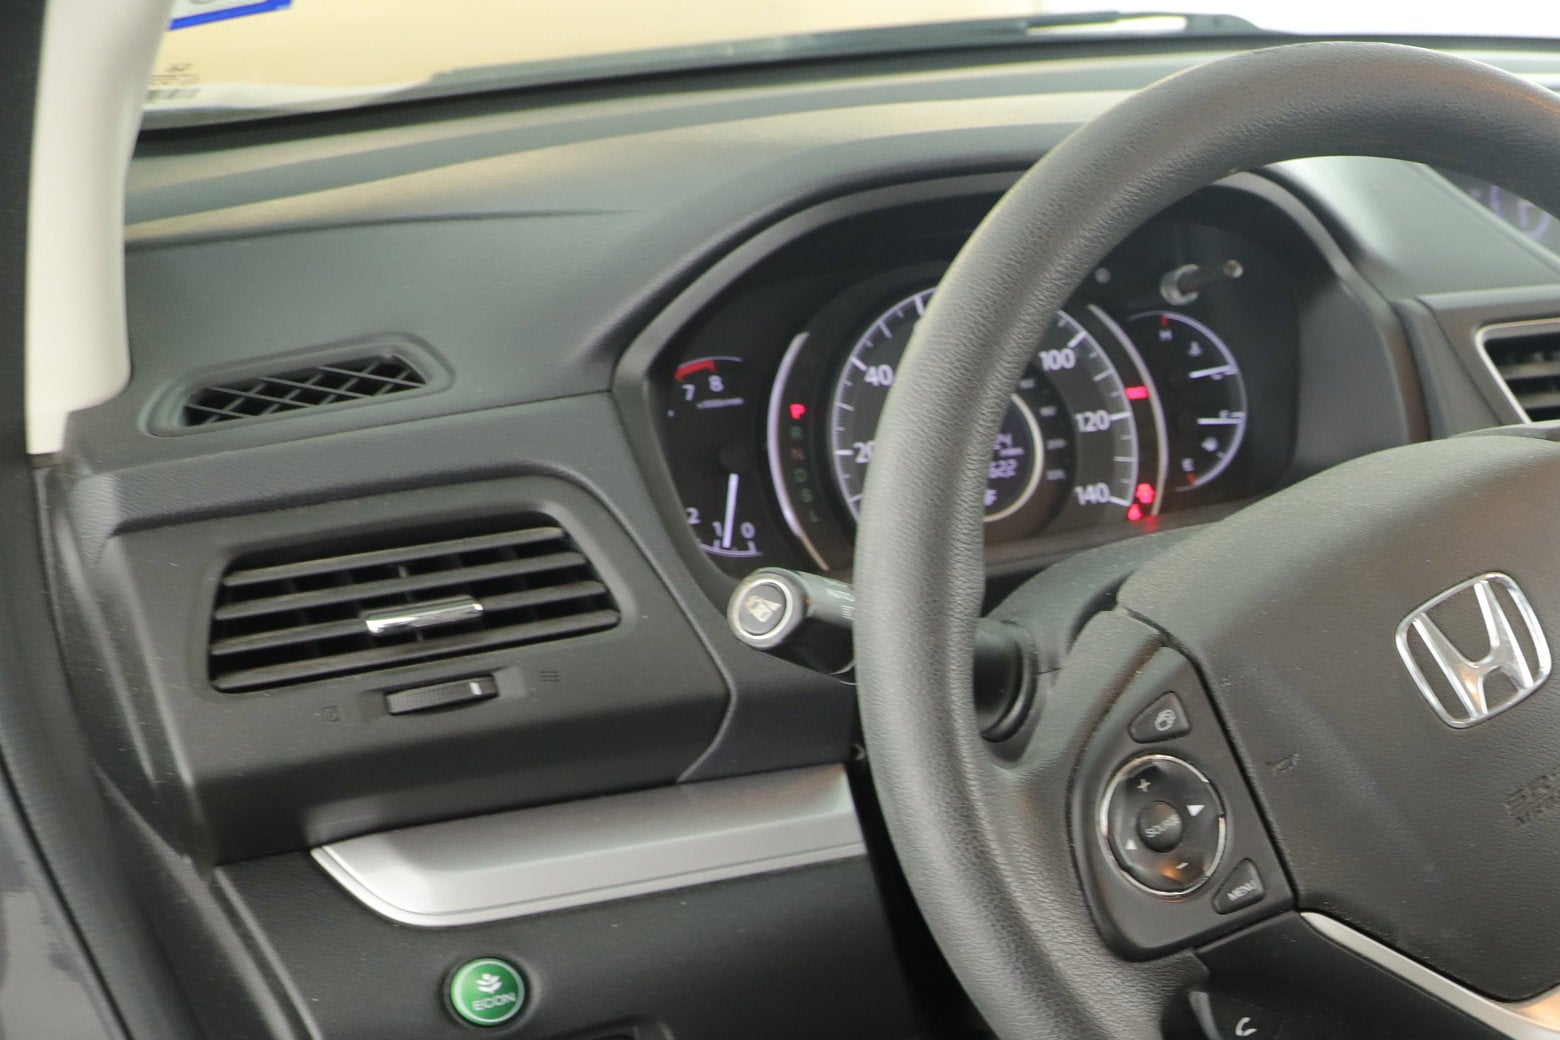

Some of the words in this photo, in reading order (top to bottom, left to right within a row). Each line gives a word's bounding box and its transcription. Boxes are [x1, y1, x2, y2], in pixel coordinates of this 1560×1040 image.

[1038, 347, 1077, 372] 100
[708, 374, 724, 392] 8
[863, 364, 894, 388] 40
[681, 384, 696, 401] 7
[788, 403, 806, 419] P
[1074, 409, 1112, 433] 120
[1074, 482, 1111, 507] 140
[685, 506, 701, 526] 2
[740, 521, 756, 539] 0
[1226, 879, 1258, 902] MENU
[471, 991, 517, 1011] ECON
